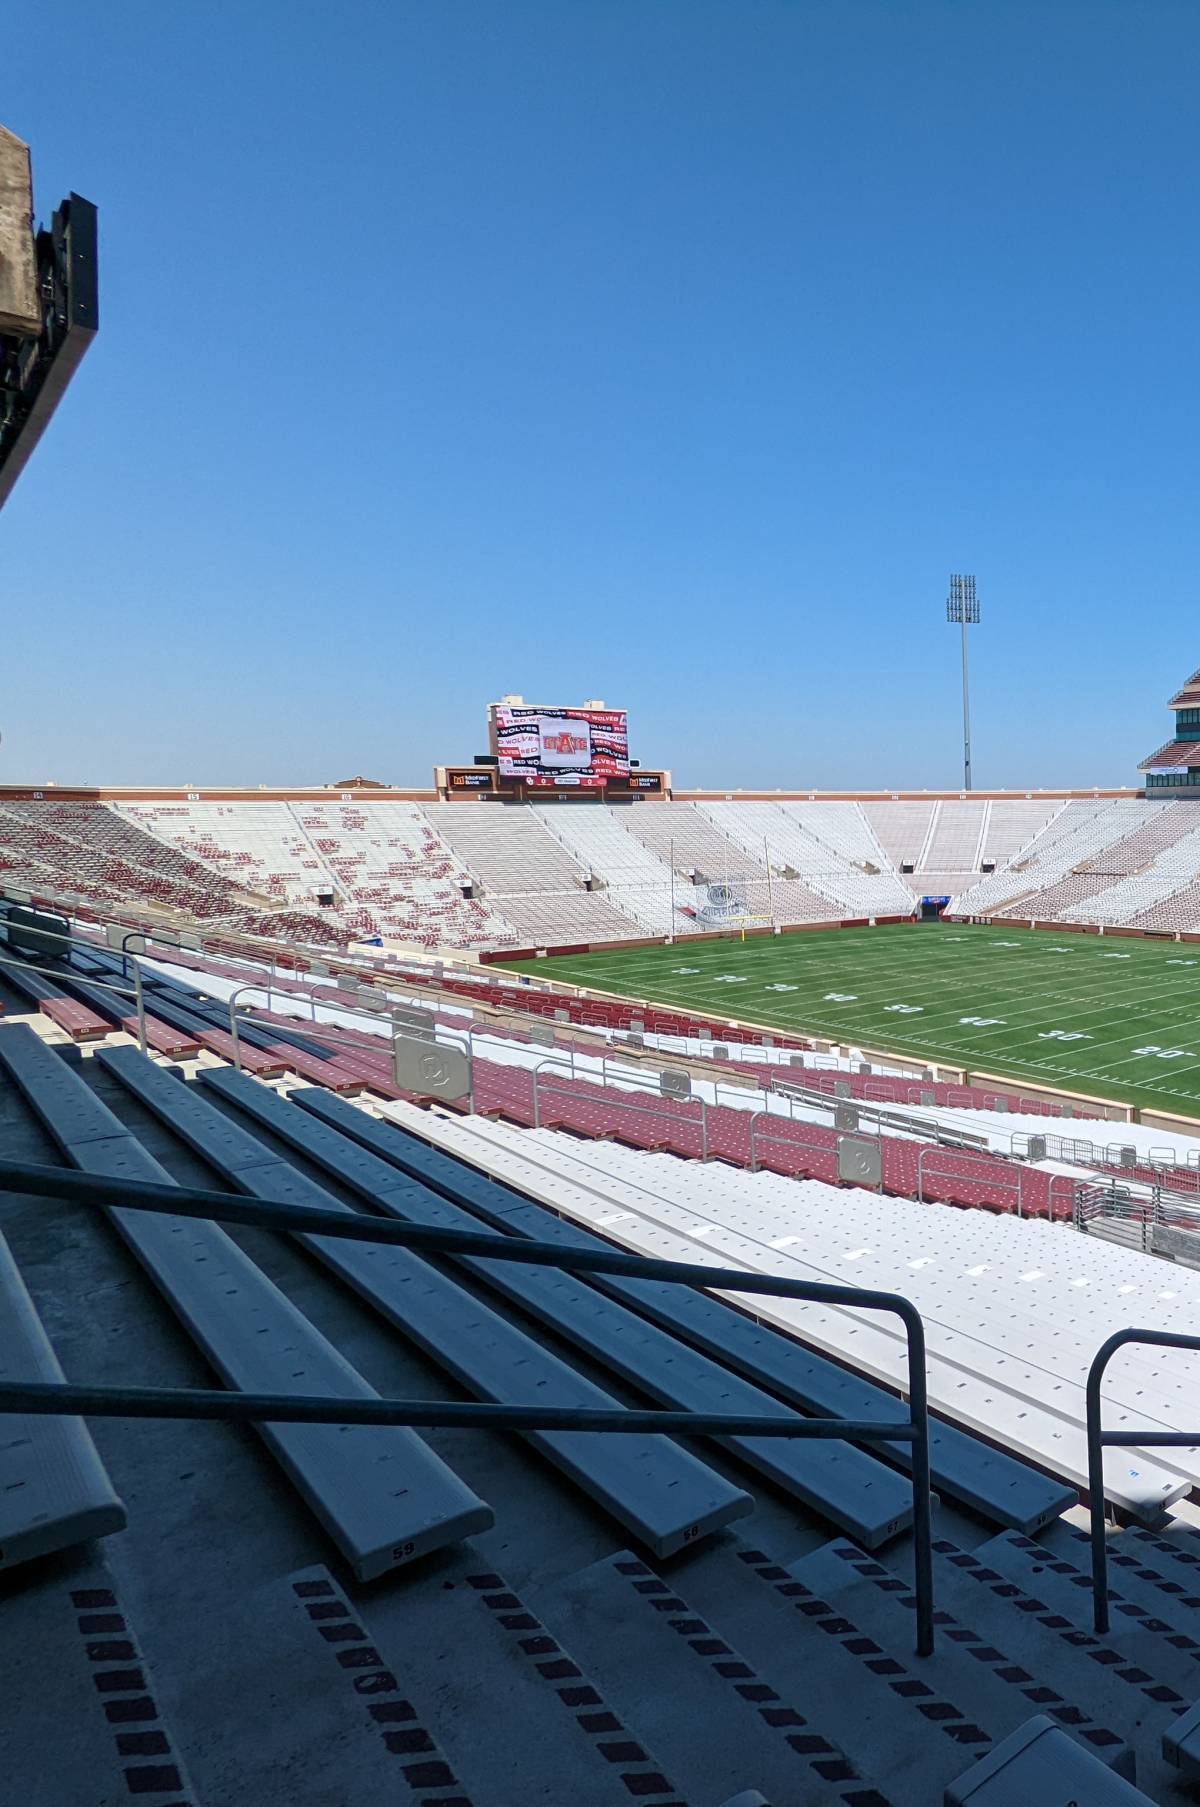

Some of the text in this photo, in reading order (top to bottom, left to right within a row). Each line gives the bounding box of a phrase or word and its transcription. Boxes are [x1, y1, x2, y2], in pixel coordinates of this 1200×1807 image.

[501, 726, 538, 734] WOLVES
[883, 1004, 924, 1014] 50
[1038, 1030, 1084, 1041] 30
[1130, 1046, 1186, 1058] 20
